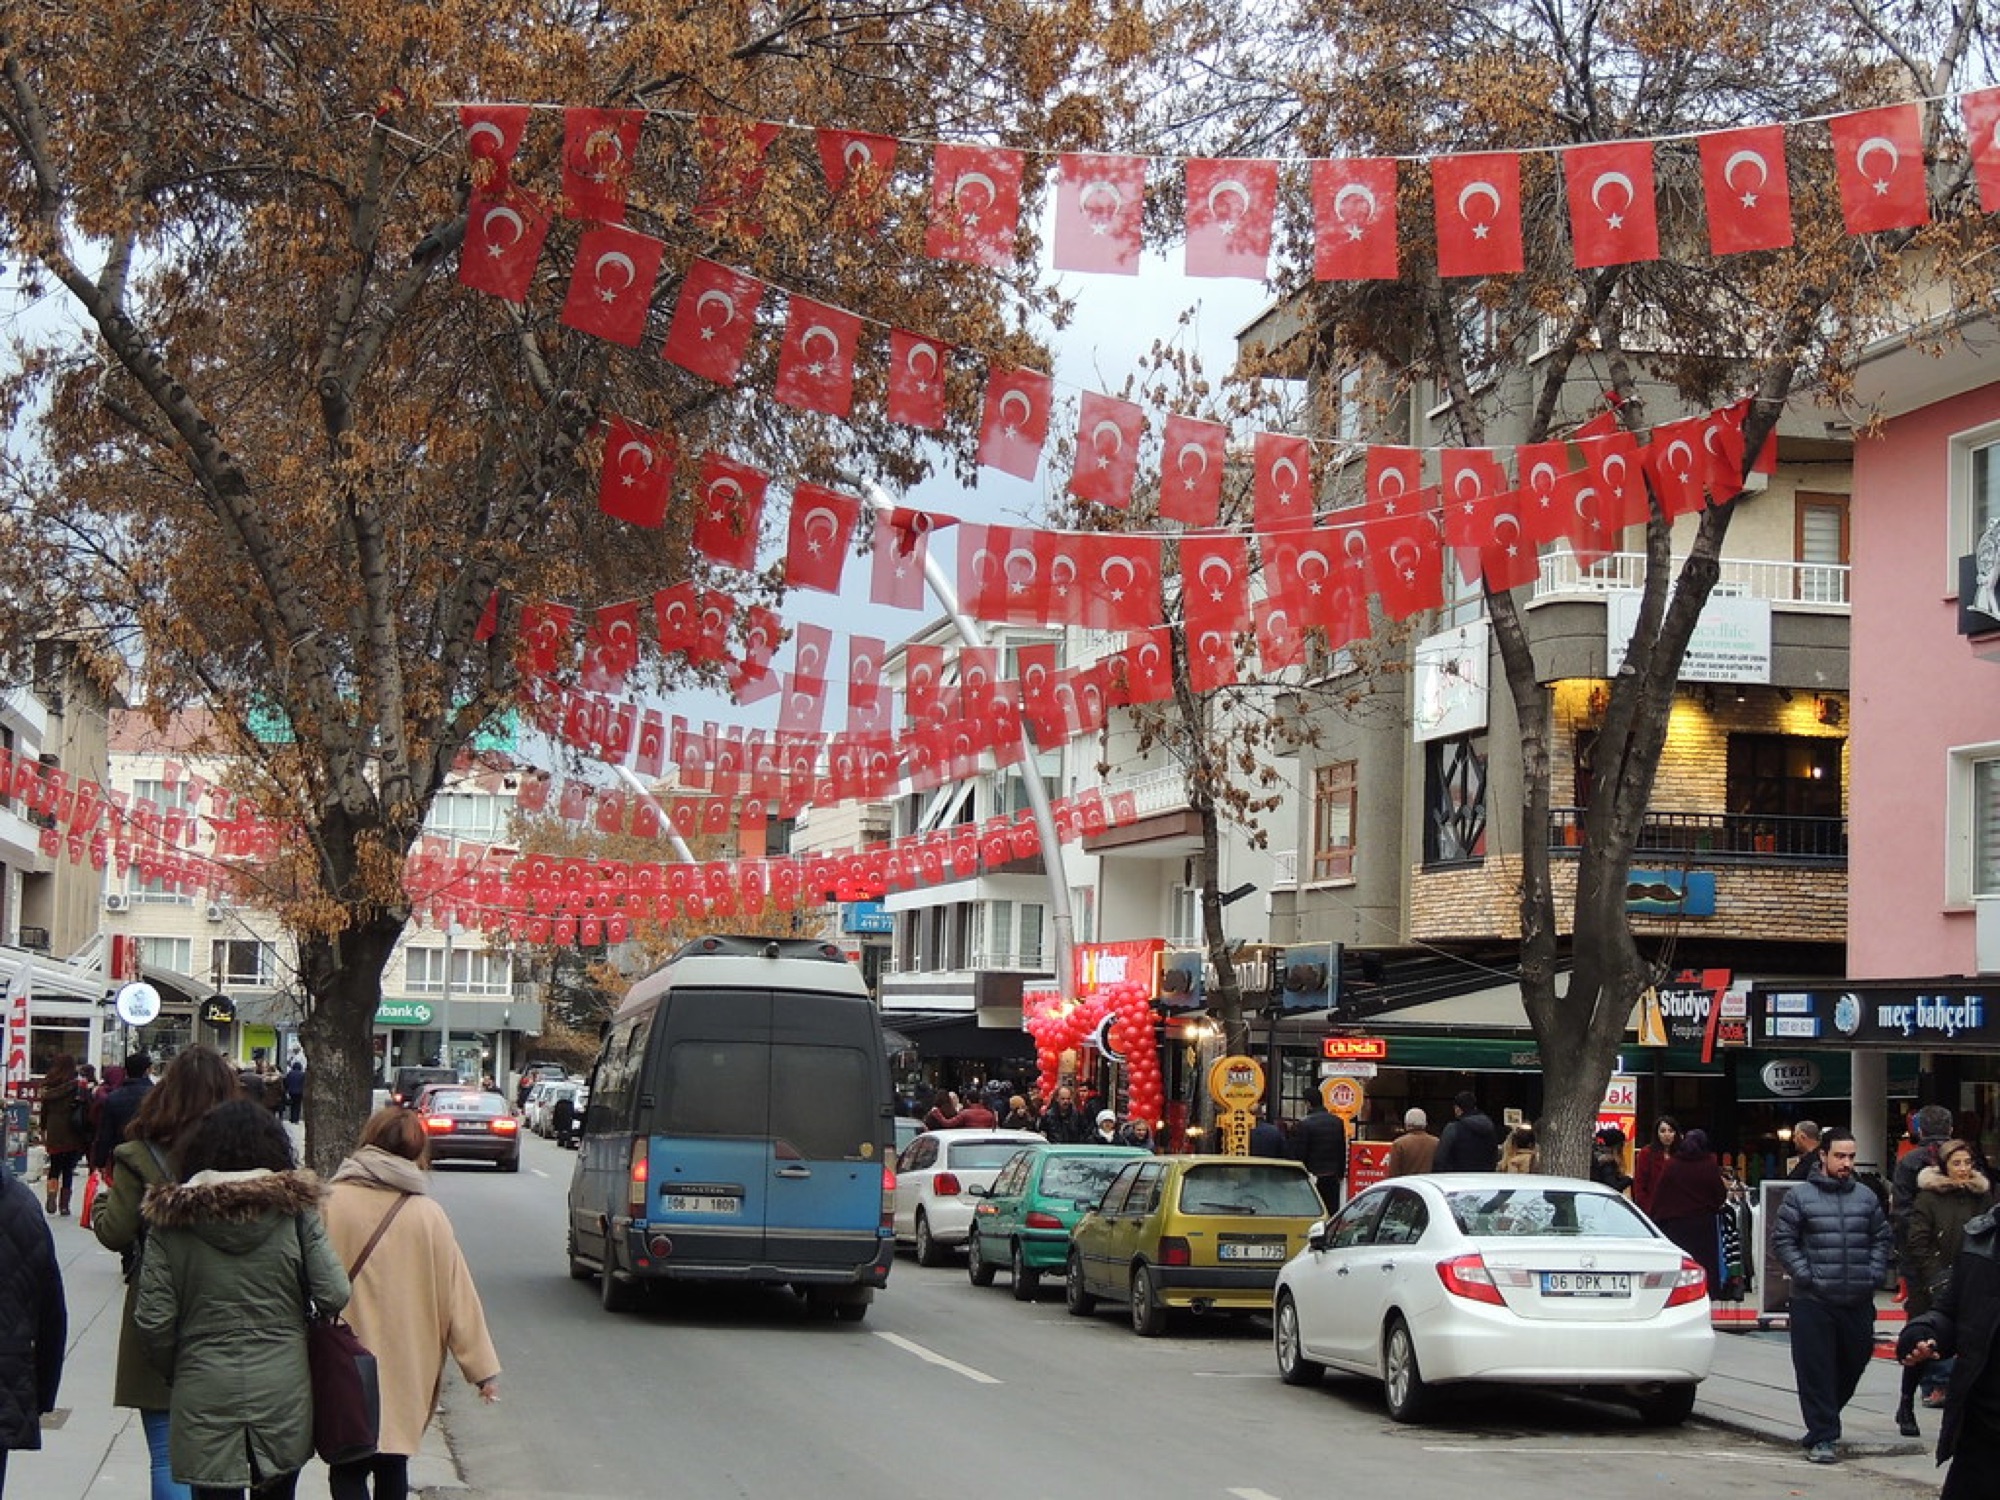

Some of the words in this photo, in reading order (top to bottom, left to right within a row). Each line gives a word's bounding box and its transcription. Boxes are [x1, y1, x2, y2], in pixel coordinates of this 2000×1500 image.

[377, 1004, 413, 1017] rbank
[1661, 990, 1709, 1023] Stüdyo
[1700, 968, 1731, 1063] 7
[1878, 1004, 1910, 1037] meç
[1916, 995, 1978, 1038] bahçeli
[1773, 1062, 1810, 1078] TERZİ
[1608, 1085, 1634, 1105] ak
[1550, 1274, 1568, 1290] 06
[1575, 1275, 1602, 1290] DPK
[1611, 1276, 1628, 1290] 14
